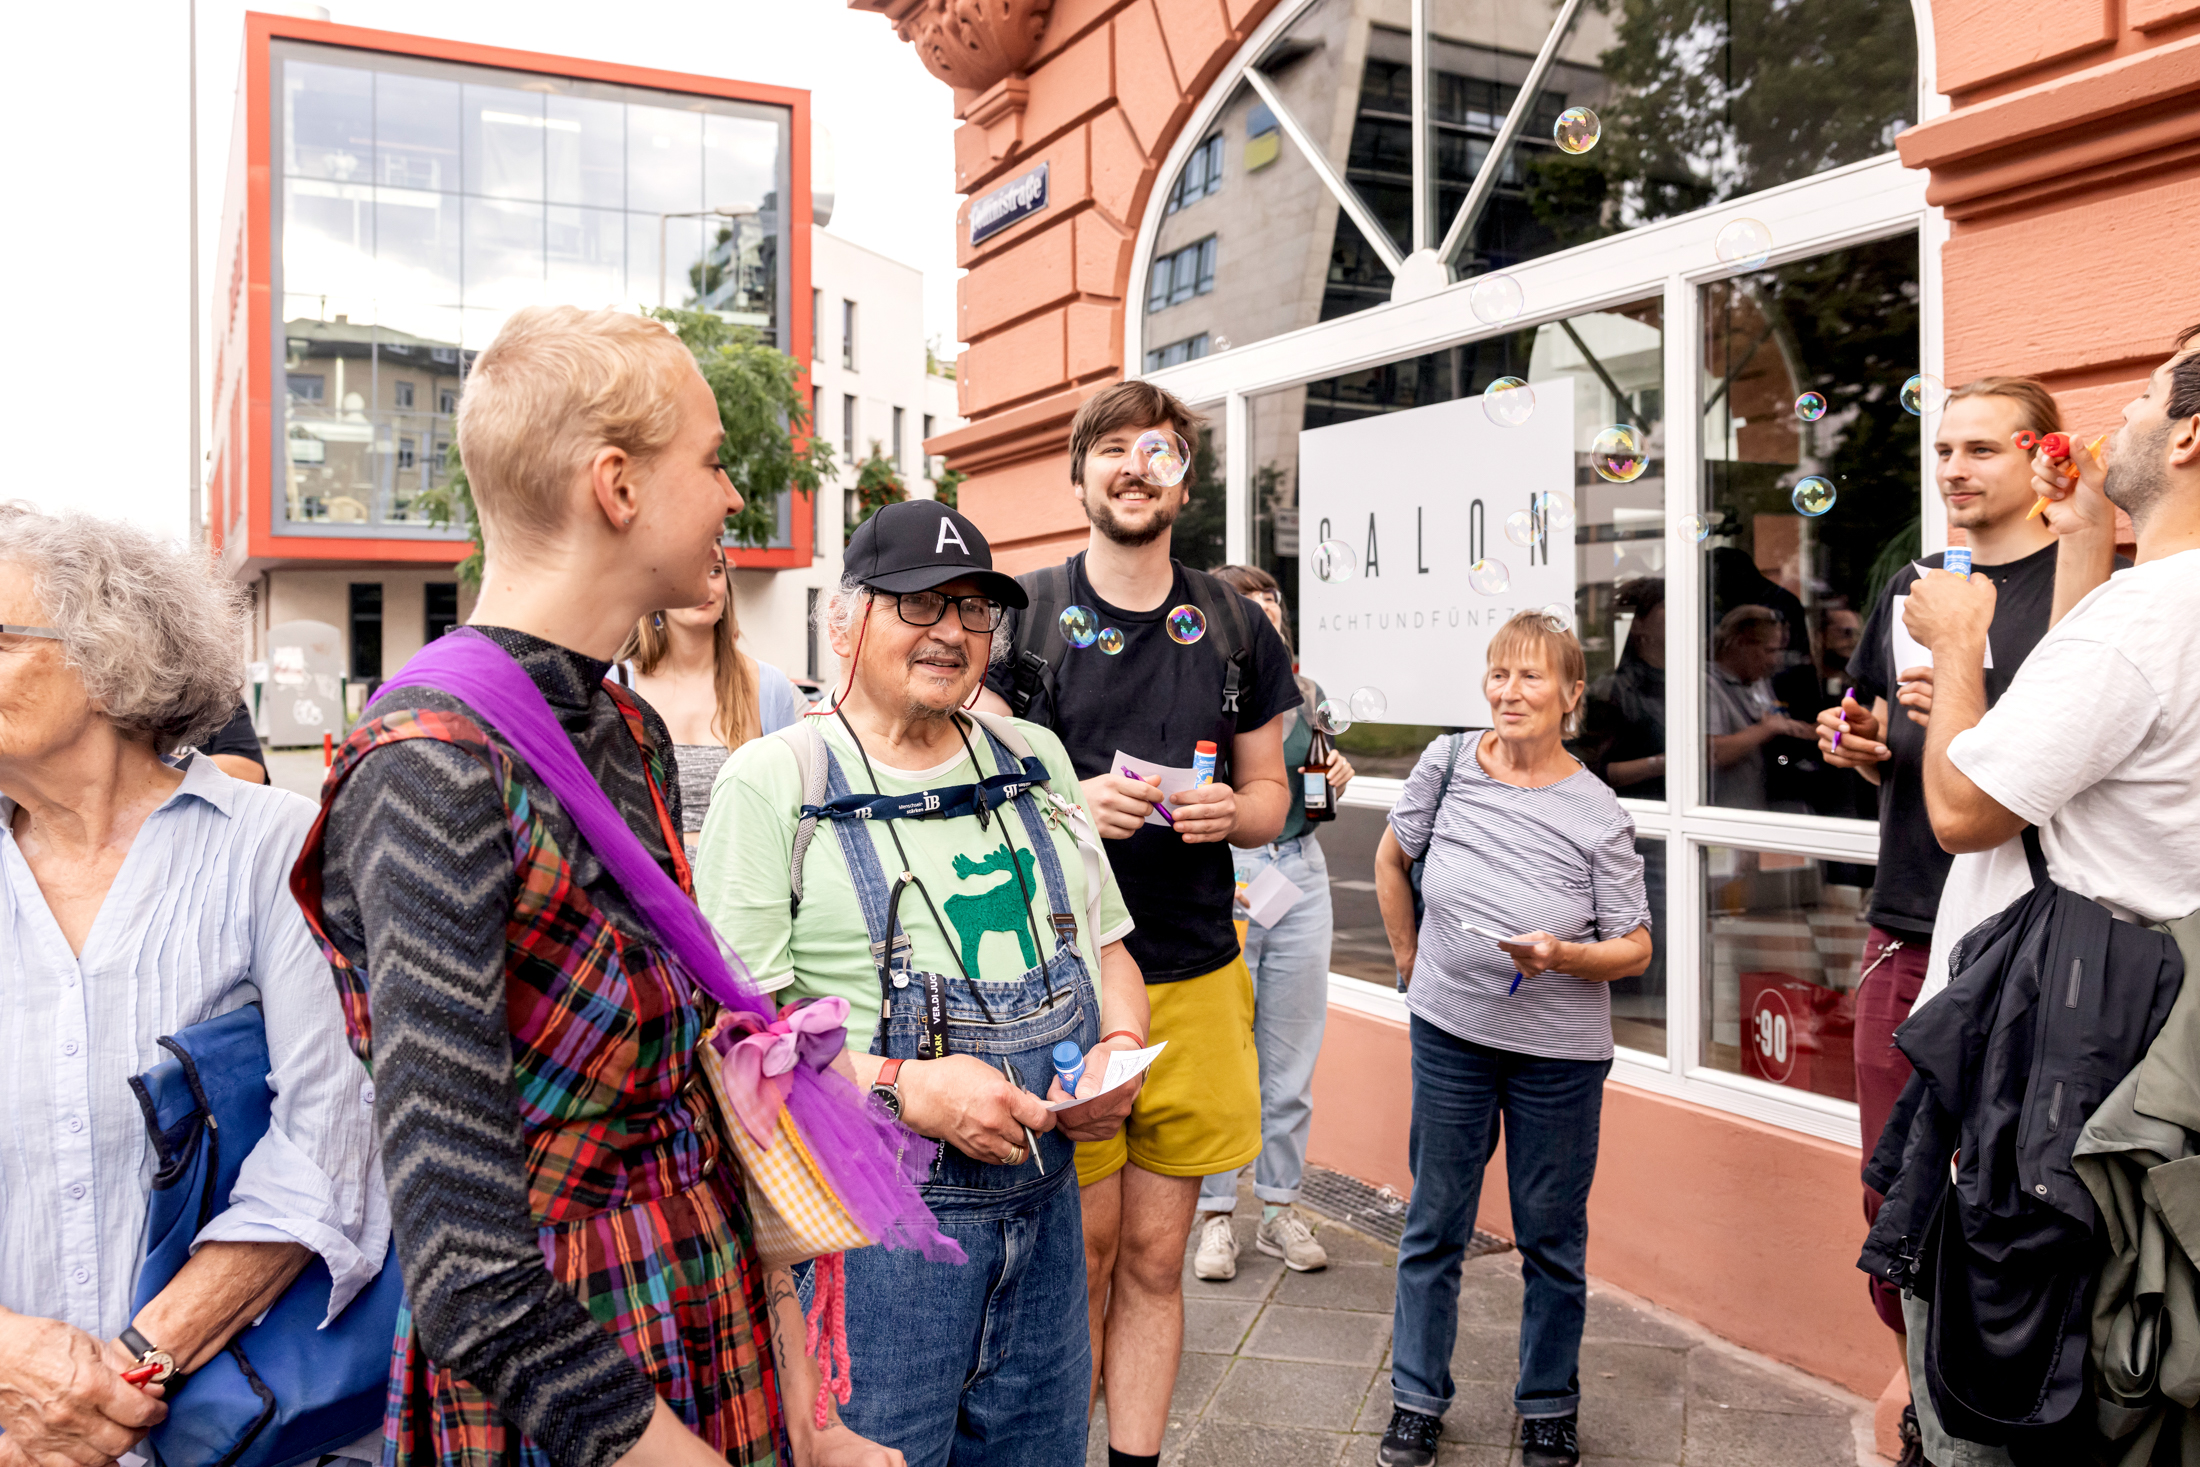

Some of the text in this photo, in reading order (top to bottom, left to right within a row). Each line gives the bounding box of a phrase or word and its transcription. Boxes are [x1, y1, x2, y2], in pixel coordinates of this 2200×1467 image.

[935, 516, 970, 555] A
[1319, 490, 1548, 581] SALON
[1318, 606, 1516, 632] ACHTUNDFÜNFZ
[931, 994, 941, 1025] VER.DI
